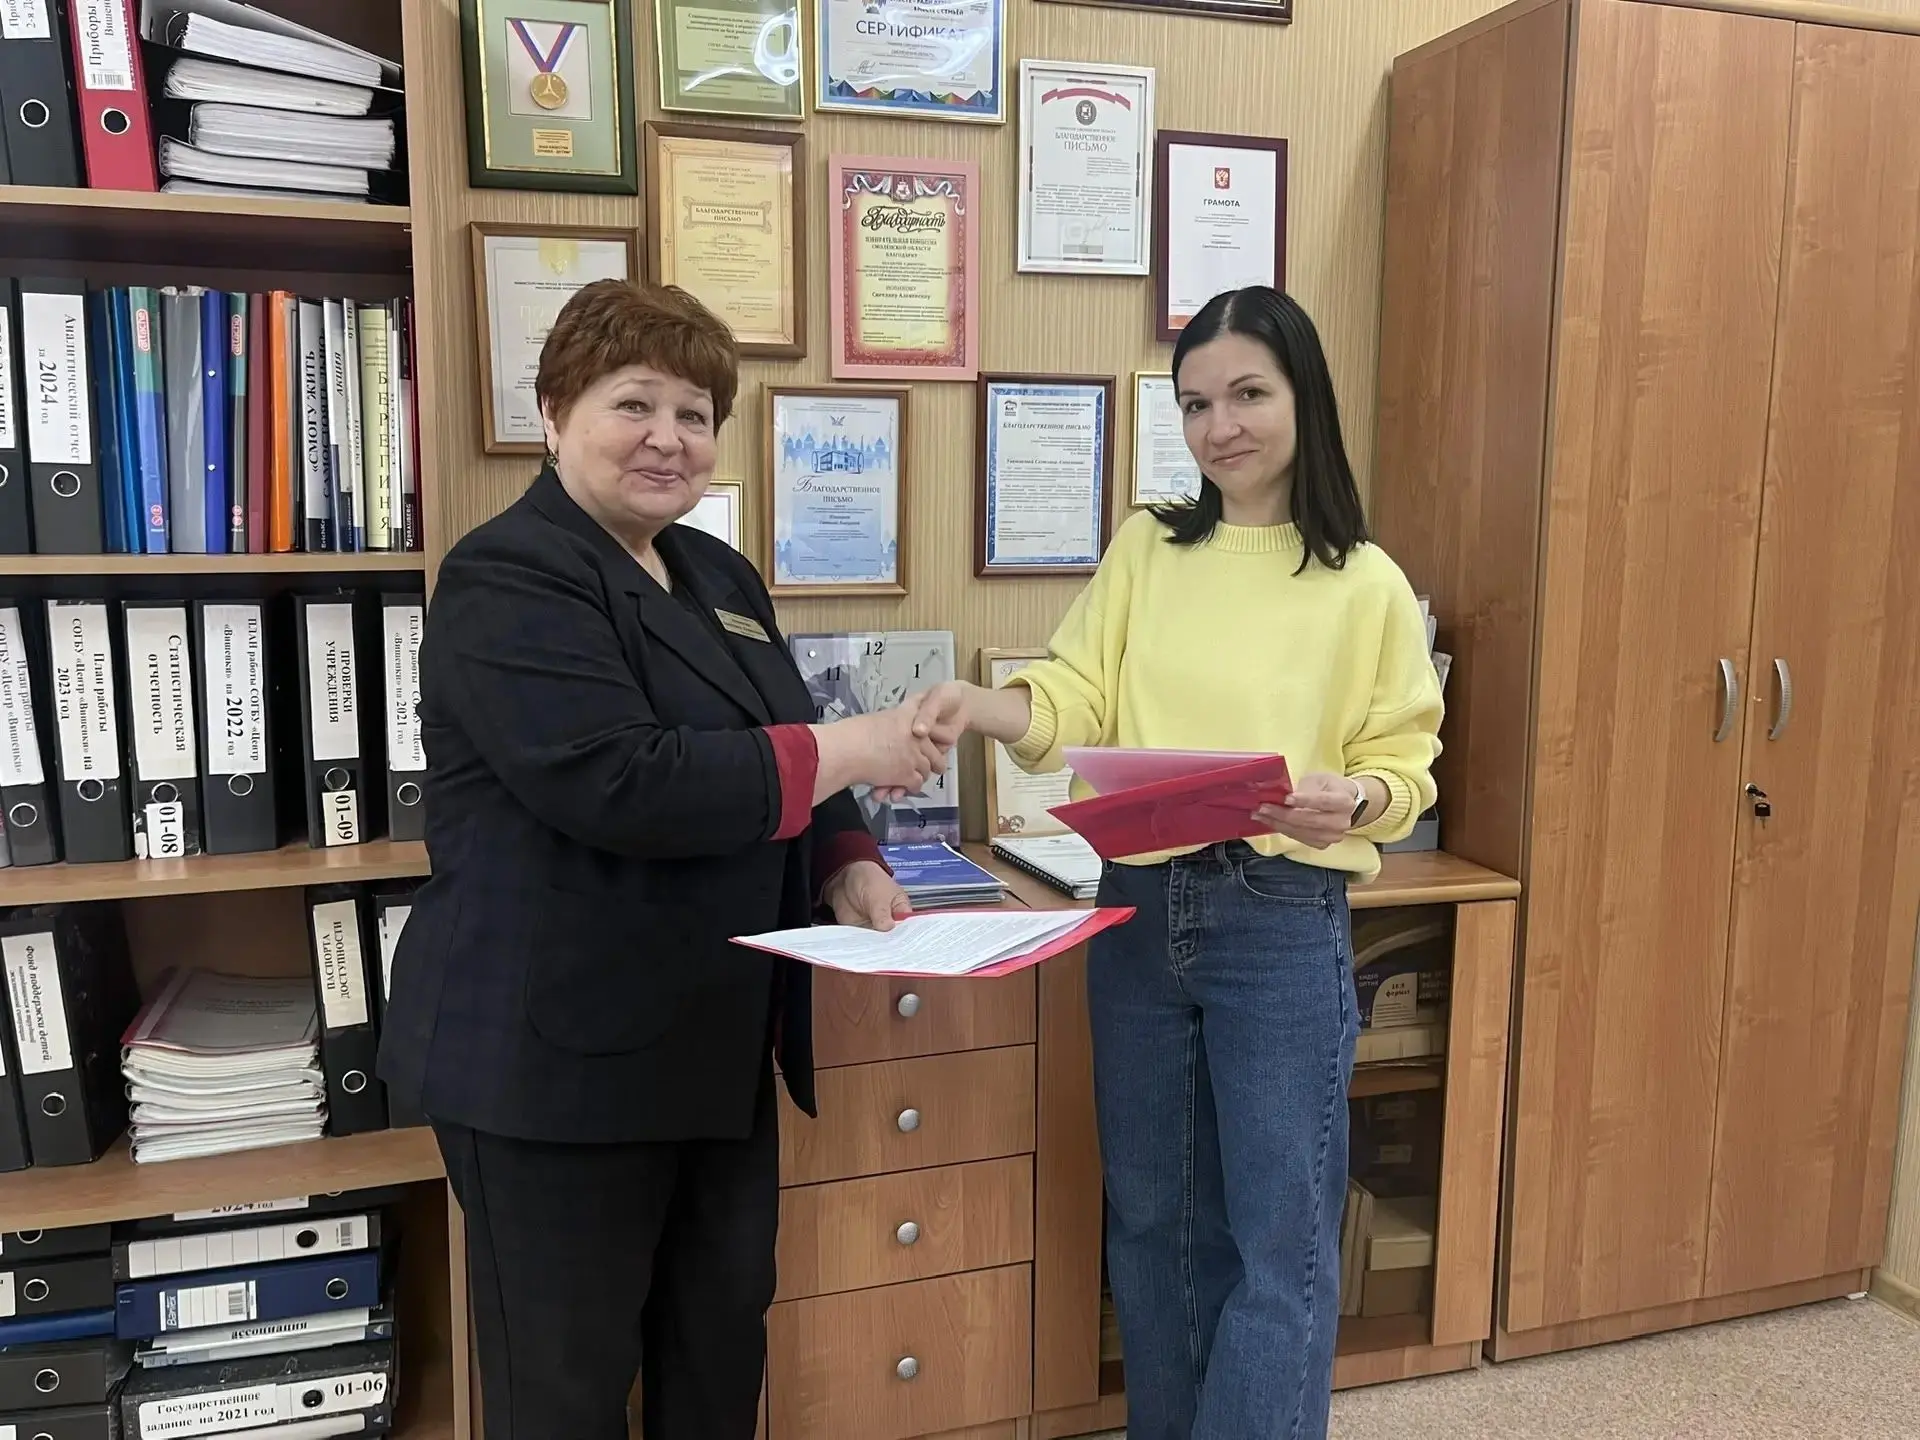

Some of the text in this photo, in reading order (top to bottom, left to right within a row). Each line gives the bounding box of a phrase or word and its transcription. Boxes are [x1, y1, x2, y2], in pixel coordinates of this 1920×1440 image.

[86, 6, 104, 65] Приборы
[856, 20, 968, 41] СЕРТИФИКАТ
[1064, 142, 1107, 152] ПИСЬМО
[695, 207, 759, 217] БЛАГОДАРСТВЕННОЕ
[713, 215, 742, 223] ПИСЬМО
[1203, 198, 1241, 208] ГРАМОТА
[39, 360, 59, 405] 2024
[64, 313, 81, 460] Аналитический отчет
[305, 350, 317, 400] ЖИТЬ
[334, 351, 344, 397] АКЦИЯ
[792, 475, 881, 494] БЛАГОДАРСТВЕННОЕ
[247, 618, 258, 649] ПЛАН
[409, 615, 419, 645] ПЛАН
[864, 641, 884, 656] 12
[246, 651, 259, 686] работы
[325, 640, 339, 723] УЧРЕЖДЕНИЯ
[340, 650, 353, 713] ПРОВЕРКИ
[409, 650, 419, 684] работы
[825, 666, 842, 682] 11
[912, 663, 921, 679] 1
[16, 660, 34, 732] План работы
[57, 667, 71, 720] 2023 год
[72, 618, 85, 655] СОГБУ
[83, 756, 93, 770] на
[93, 653, 109, 732] План работы
[148, 653, 163, 735] отчетность
[168, 634, 186, 752] Статистическая
[225, 683, 233, 695] на
[395, 687, 402, 699] на
[226, 697, 244, 738] 2022
[250, 688, 260, 724] СОГБУ
[396, 701, 408, 726] 2021
[227, 740, 235, 756] год
[936, 773, 945, 790] 4
[159, 806, 178, 854] 01-08
[335, 794, 354, 840] 01-09
[918, 814, 928, 829] 5
[322, 933, 336, 990] ПАСПОРТА
[333, 920, 351, 999] ДОСТУПНОСТИ
[26, 945, 52, 1062] Фонд поддержки детей
[166, 1295, 177, 1327] Bantex
[230, 1321, 308, 1340] ассоциации
[156, 1392, 261, 1415] Государственное
[334, 1378, 384, 1397] 01-06
[145, 1407, 275, 1433] задание на 2021 год
